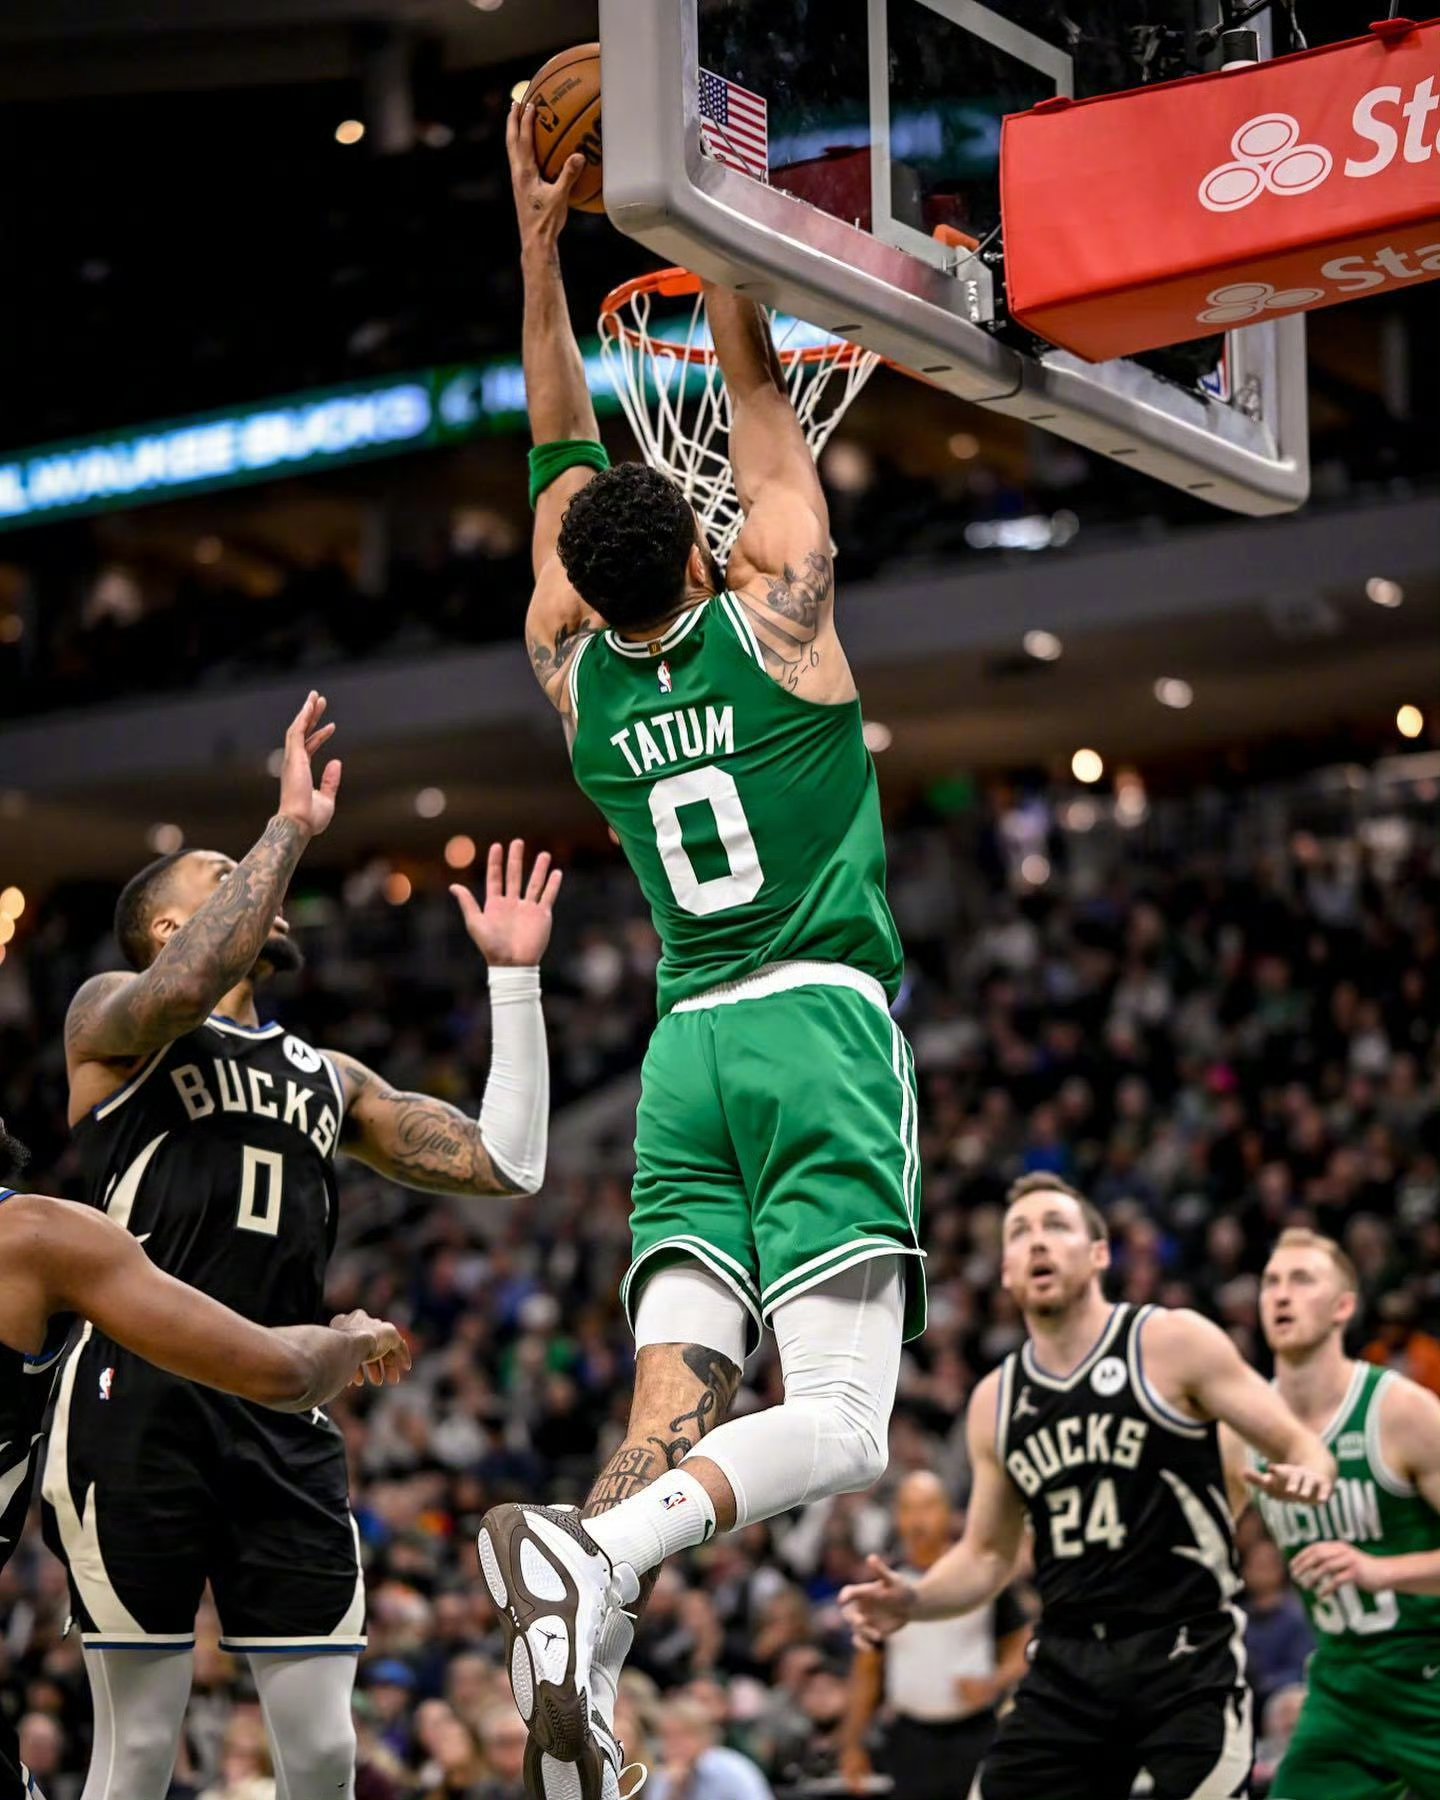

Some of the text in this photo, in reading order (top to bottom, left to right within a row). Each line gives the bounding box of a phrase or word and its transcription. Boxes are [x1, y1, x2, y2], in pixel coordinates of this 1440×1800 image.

[1344, 75, 1440, 178] St
[610, 706, 734, 777] TATUM
[648, 764, 765, 916] 0
[170, 1058, 337, 1159] BUCKS
[236, 1144, 284, 1236] 0
[1007, 1412, 1148, 1498] BUCKS
[1045, 1477, 1127, 1559] 24
